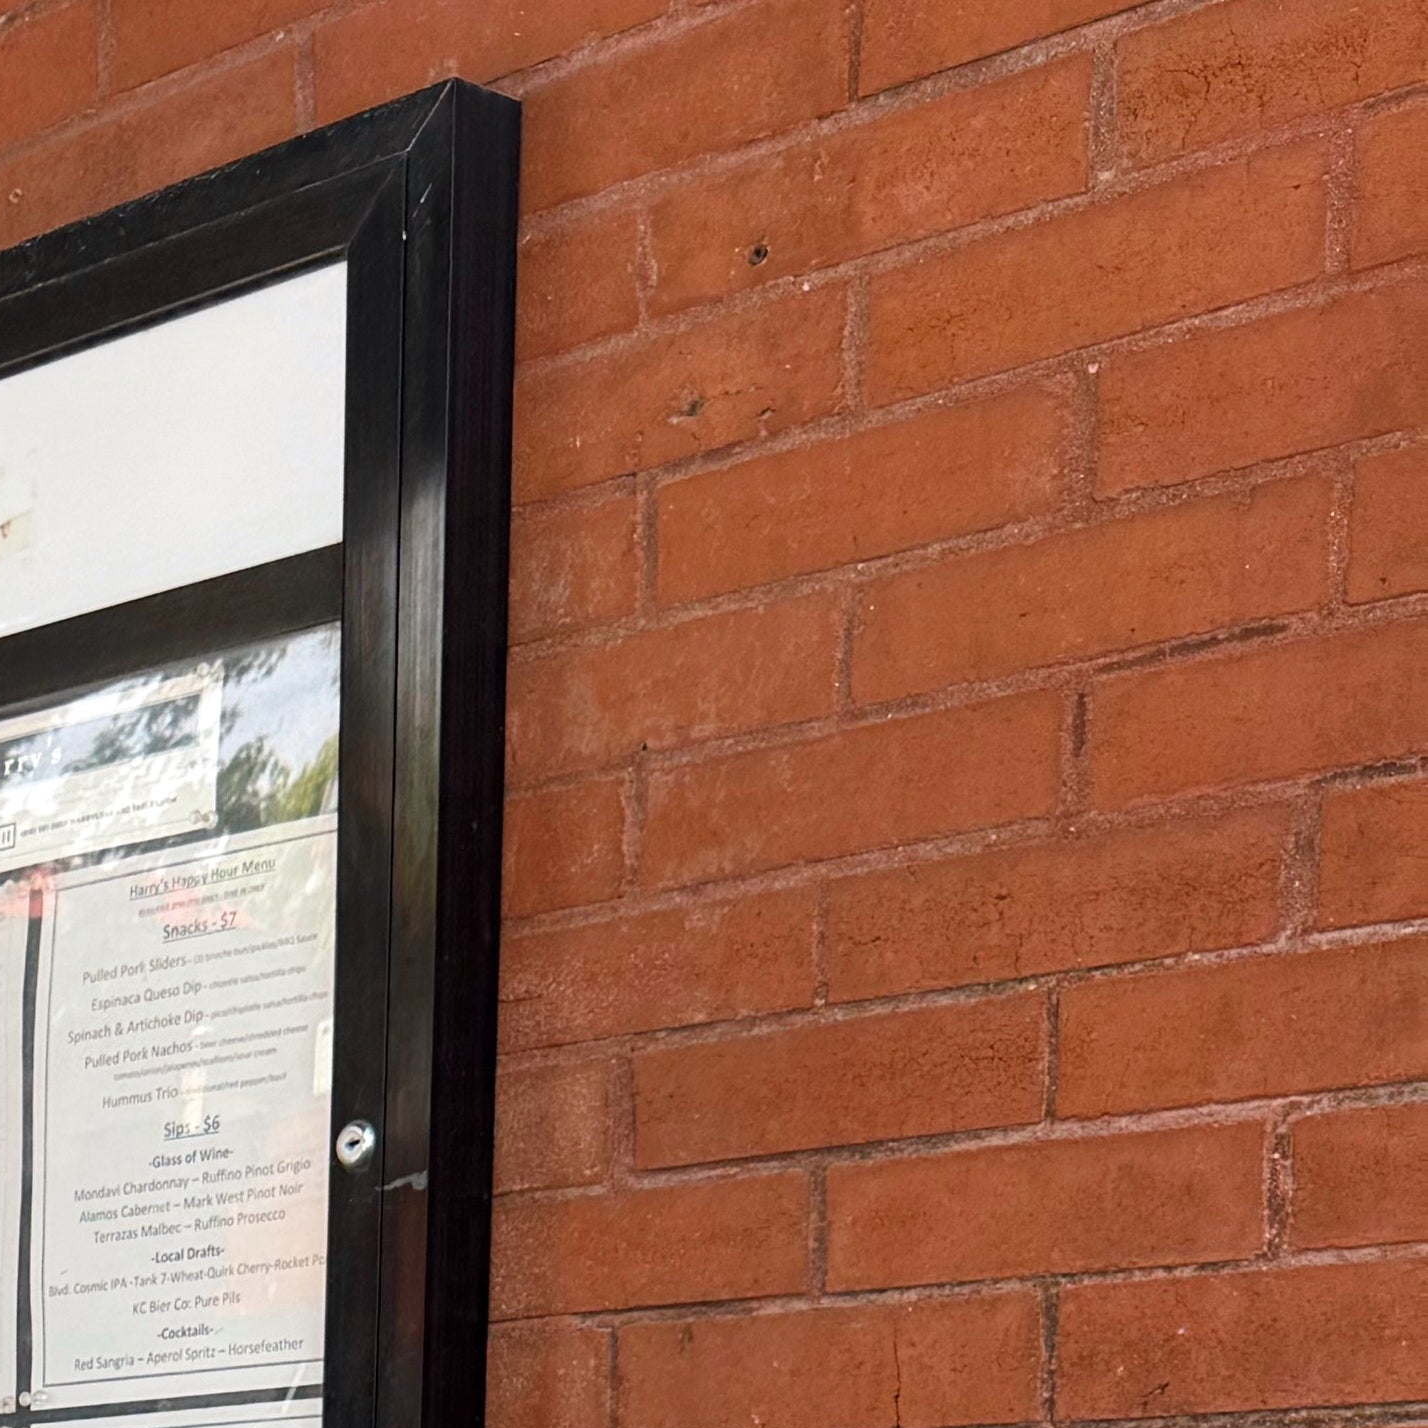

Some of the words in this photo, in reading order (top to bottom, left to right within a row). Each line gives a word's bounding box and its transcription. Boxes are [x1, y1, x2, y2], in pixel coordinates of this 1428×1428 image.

[130, 879, 168, 900] Harry's
[172, 870, 208, 893] Happy
[211, 866, 238, 881] Hour
[242, 857, 276, 874] Menu
[163, 917, 208, 939] Snacks
[220, 911, 238, 930] $7
[82, 967, 117, 985] Pulled
[91, 992, 141, 1012] Espinaca
[144, 985, 180, 1003] Queso
[183, 980, 202, 997] Dip
[68, 1025, 111, 1045] Spinach
[115, 1022, 123, 1035] &
[126, 1013, 181, 1033] Artichoke
[184, 1009, 204, 1025] Dip
[84, 1051, 120, 1070] Pulled
[122, 1047, 148, 1063] Pork
[151, 1041, 193, 1060] Nachos
[102, 1091, 153, 1109] Hummus
[155, 1087, 179, 1101] Trio
[164, 1120, 191, 1140] Sips
[203, 1114, 221, 1134] $6
[149, 1152, 183, 1169] -Glass
[185, 1150, 196, 1164] of
[199, 1147, 234, 1162] Wine-
[74, 1184, 120, 1202] Mondavi
[123, 1176, 190, 1197] Chardonnay
[202, 1169, 242, 1185] Ruffino
[245, 1164, 274, 1179] Pinot
[277, 1157, 311, 1175] Grigio
[79, 1209, 118, 1225] Alamos
[121, 1202, 171, 1219] Cabernet
[184, 1194, 213, 1210] Mark
[216, 1190, 244, 1206] West
[247, 1186, 276, 1201] Pinot
[279, 1182, 303, 1197] Noir
[93, 1229, 138, 1244] Terrazas
[141, 1222, 182, 1238] Malbec
[194, 1216, 234, 1232] Ruffino
[237, 1209, 286, 1226] Prosecco
[151, 1248, 184, 1264] -Local
[187, 1244, 225, 1260] Drafts-
[73, 1279, 108, 1294] Cosmic
[110, 1276, 128, 1291] IPA
[133, 1302, 147, 1315] KC
[149, 1299, 172, 1314] Bier
[195, 1294, 220, 1309] Pure
[222, 1291, 241, 1306] Pils
[157, 1323, 214, 1340] -Cocktails-
[74, 1358, 93, 1372] Red
[96, 1354, 135, 1371] Sangria
[147, 1349, 182, 1366] Aperol
[185, 1345, 216, 1362] Spritz
[229, 1337, 304, 1357] Horsefeather
